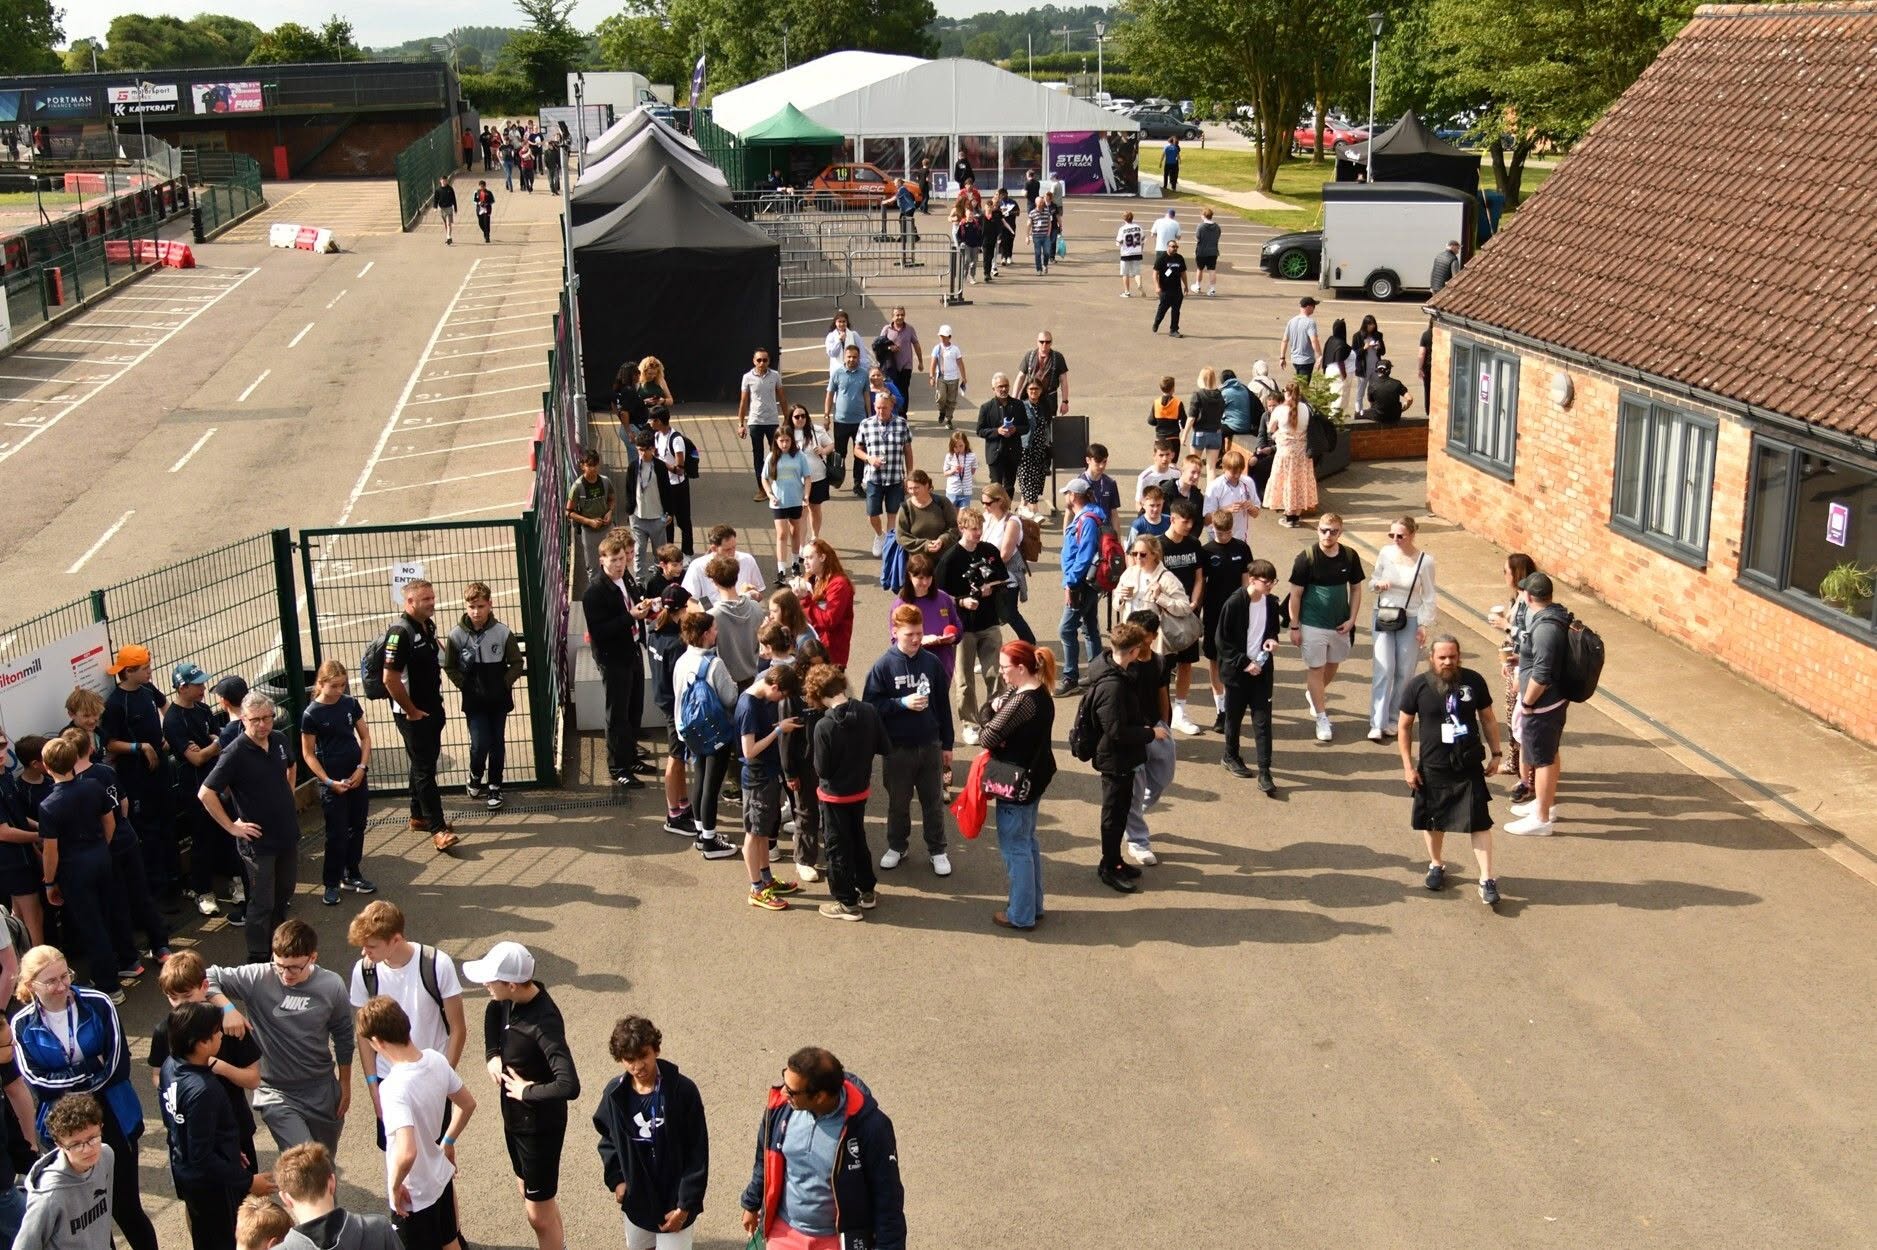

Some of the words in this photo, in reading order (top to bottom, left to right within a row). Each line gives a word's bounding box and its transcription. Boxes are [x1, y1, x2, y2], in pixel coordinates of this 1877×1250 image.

[47, 96, 92, 104] PORTMAN
[129, 104, 176, 113] KARTKRAFT
[1056, 154, 1093, 163] STEM
[894, 673, 929, 689] FILA
[280, 995, 311, 1010] NIKE
[70, 1197, 108, 1236] PUMA
